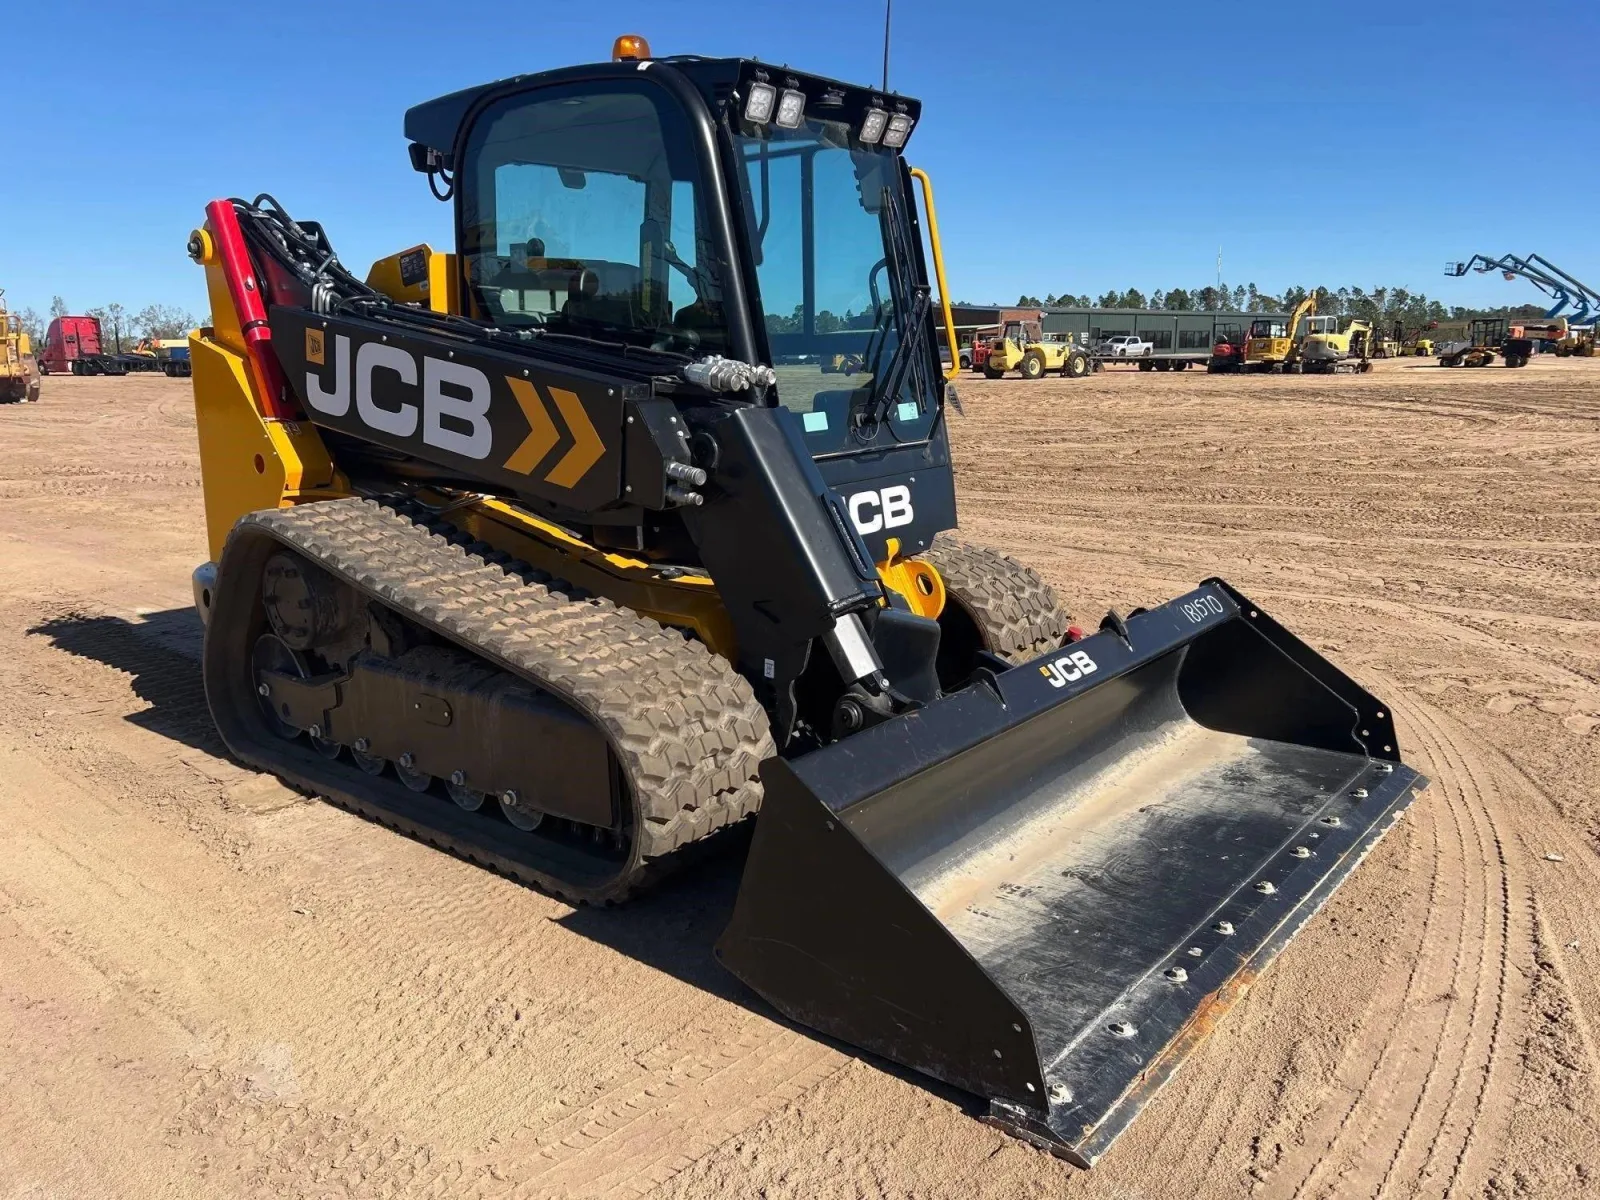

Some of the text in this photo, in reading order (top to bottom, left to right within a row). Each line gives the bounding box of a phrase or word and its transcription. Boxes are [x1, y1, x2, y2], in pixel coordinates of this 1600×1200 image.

[306, 334, 492, 460] JCB
[842, 485, 914, 535] CB
[1180, 595, 1224, 623] 181570
[1048, 650, 1098, 688] JCB
